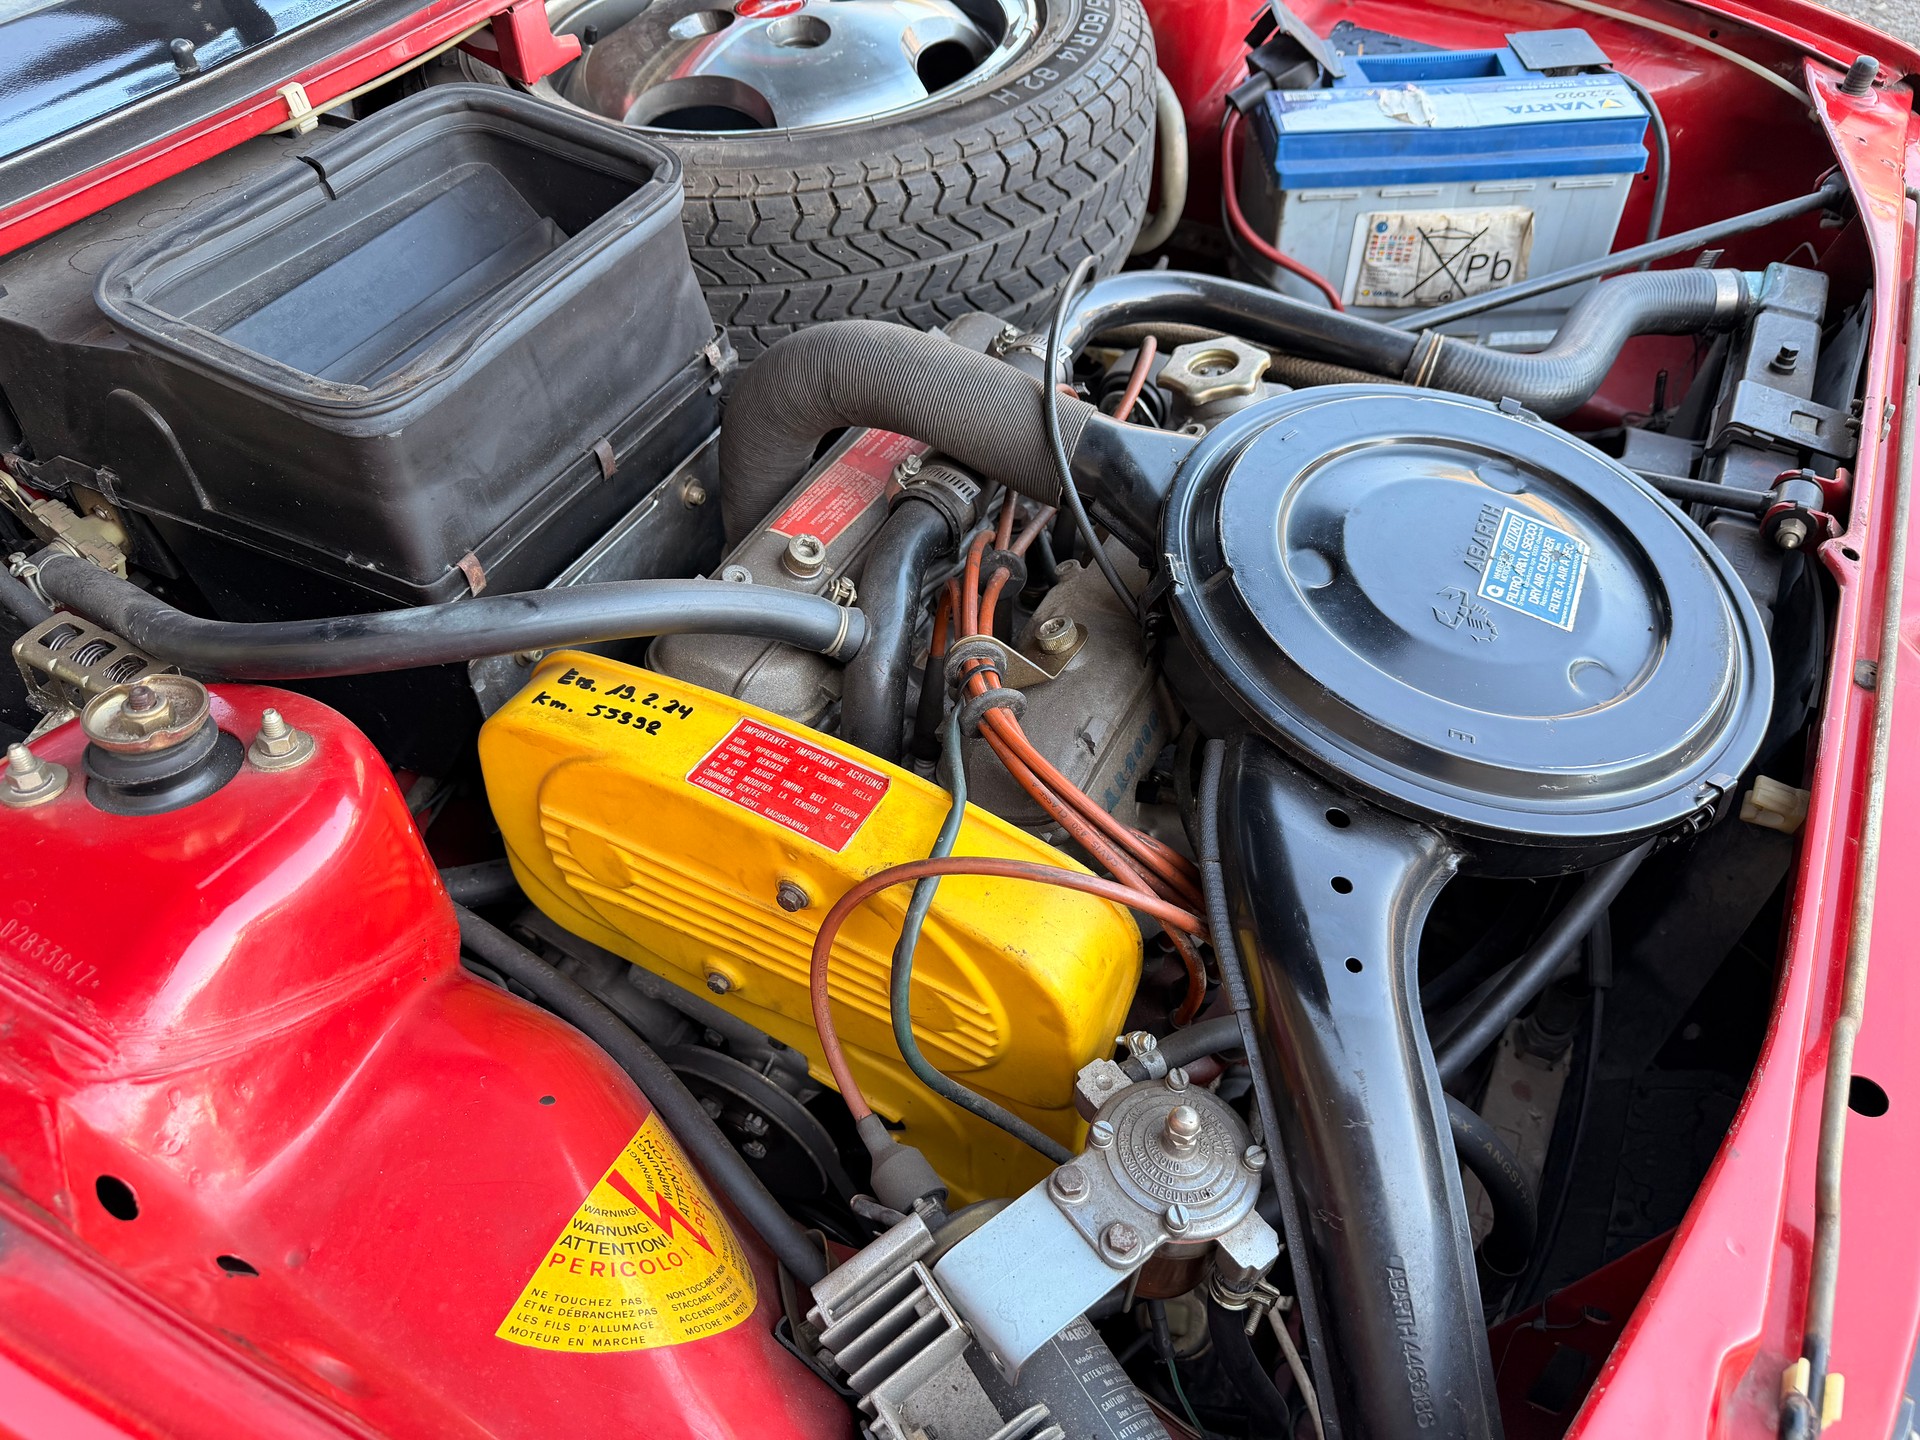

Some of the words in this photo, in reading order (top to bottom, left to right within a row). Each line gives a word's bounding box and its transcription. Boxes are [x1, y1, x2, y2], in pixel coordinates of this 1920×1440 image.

[1016, 67, 1060, 90] 82
[989, 88, 1020, 105] H
[1503, 100, 1595, 116] VARTA
[1464, 250, 1512, 284] Pb
[1463, 503, 1503, 574] ABARTH
[1504, 517, 1522, 549] FIAT
[1506, 576, 1523, 604] FILTRO
[1522, 522, 1538, 550] SECCO
[1533, 572, 1545, 589] AIR
[1528, 589, 1542, 605] DRY
[1548, 587, 1564, 614] FILTRE
[725, 743, 752, 758] CINGHIA
[756, 756, 784, 772] DENTATA
[732, 736, 748, 746] NON
[754, 745, 792, 765] RIPRENDERE
[798, 764, 809, 773] LA
[815, 771, 846, 789] TENSIONE
[852, 788, 873, 803] DELLA
[742, 724, 790, 749] IMPORTANTE
[795, 746, 840, 770] IMPORTANT
[846, 768, 884, 791] ACHTUNG
[702, 768, 734, 786] COURROIE
[736, 783, 762, 798] DENTEE
[709, 760, 720, 768] NE
[723, 767, 738, 777] PAS
[742, 775, 773, 793] MODIFIER
[777, 791, 788, 800] LA
[792, 798, 820, 815] TENSION
[825, 813, 836, 822] DE
[840, 820, 851, 830] LA
[717, 752, 729, 760] DO
[732, 759, 747, 768] NOT
[751, 767, 776, 781] ADJUST
[780, 779, 804, 794] TIMING
[809, 792, 827, 804] BELT
[831, 802, 860, 820] TENSION
[694, 776, 735, 798] ZAHNRIEMEN
[739, 796, 760, 809] NICHT
[764, 807, 810, 833] NACHSPANNEN
[627, 1148, 654, 1193] WARNING!
[1134, 1143, 1174, 1186] PATENTED
[1150, 1184, 1216, 1203] REGULATOR
[584, 1204, 639, 1218] WARNING!
[572, 1218, 655, 1237] WARNUNG!
[559, 1233, 672, 1256] ATTENTION!
[666, 1289, 686, 1300] NON
[686, 1276, 716, 1294] TOCCARE
[716, 1263, 726, 1276] NON
[671, 1292, 713, 1312] STACCARE
[715, 1281, 729, 1293] CAVI
[726, 1275, 734, 1284] DI
[523, 1300, 537, 1309] ET
[538, 1304, 554, 1314] NE
[558, 1307, 636, 1319] DÉBRANCHEZ
[638, 1307, 658, 1316] PAS
[531, 1288, 548, 1299] NE
[554, 1294, 612, 1307] TOUCHEZ
[621, 1298, 643, 1306] PAS
[679, 1299, 730, 1323] ACCENSIONE
[727, 1292, 738, 1303] CON
[1386, 1265, 1418, 1339] ABARTH
[516, 1312, 539, 1325] LES
[544, 1320, 571, 1331] FILS
[578, 1321, 655, 1333] D'ALLUMAGE
[684, 1318, 723, 1336] MOTORE
[722, 1313, 733, 1323] IN
[733, 1301, 748, 1317] MOTO
[508, 1325, 561, 1344] MOTEUR
[568, 1337, 584, 1347] EN
[592, 1335, 646, 1347] MARCHE
[1101, 1393, 1127, 1412] CAUTION!
